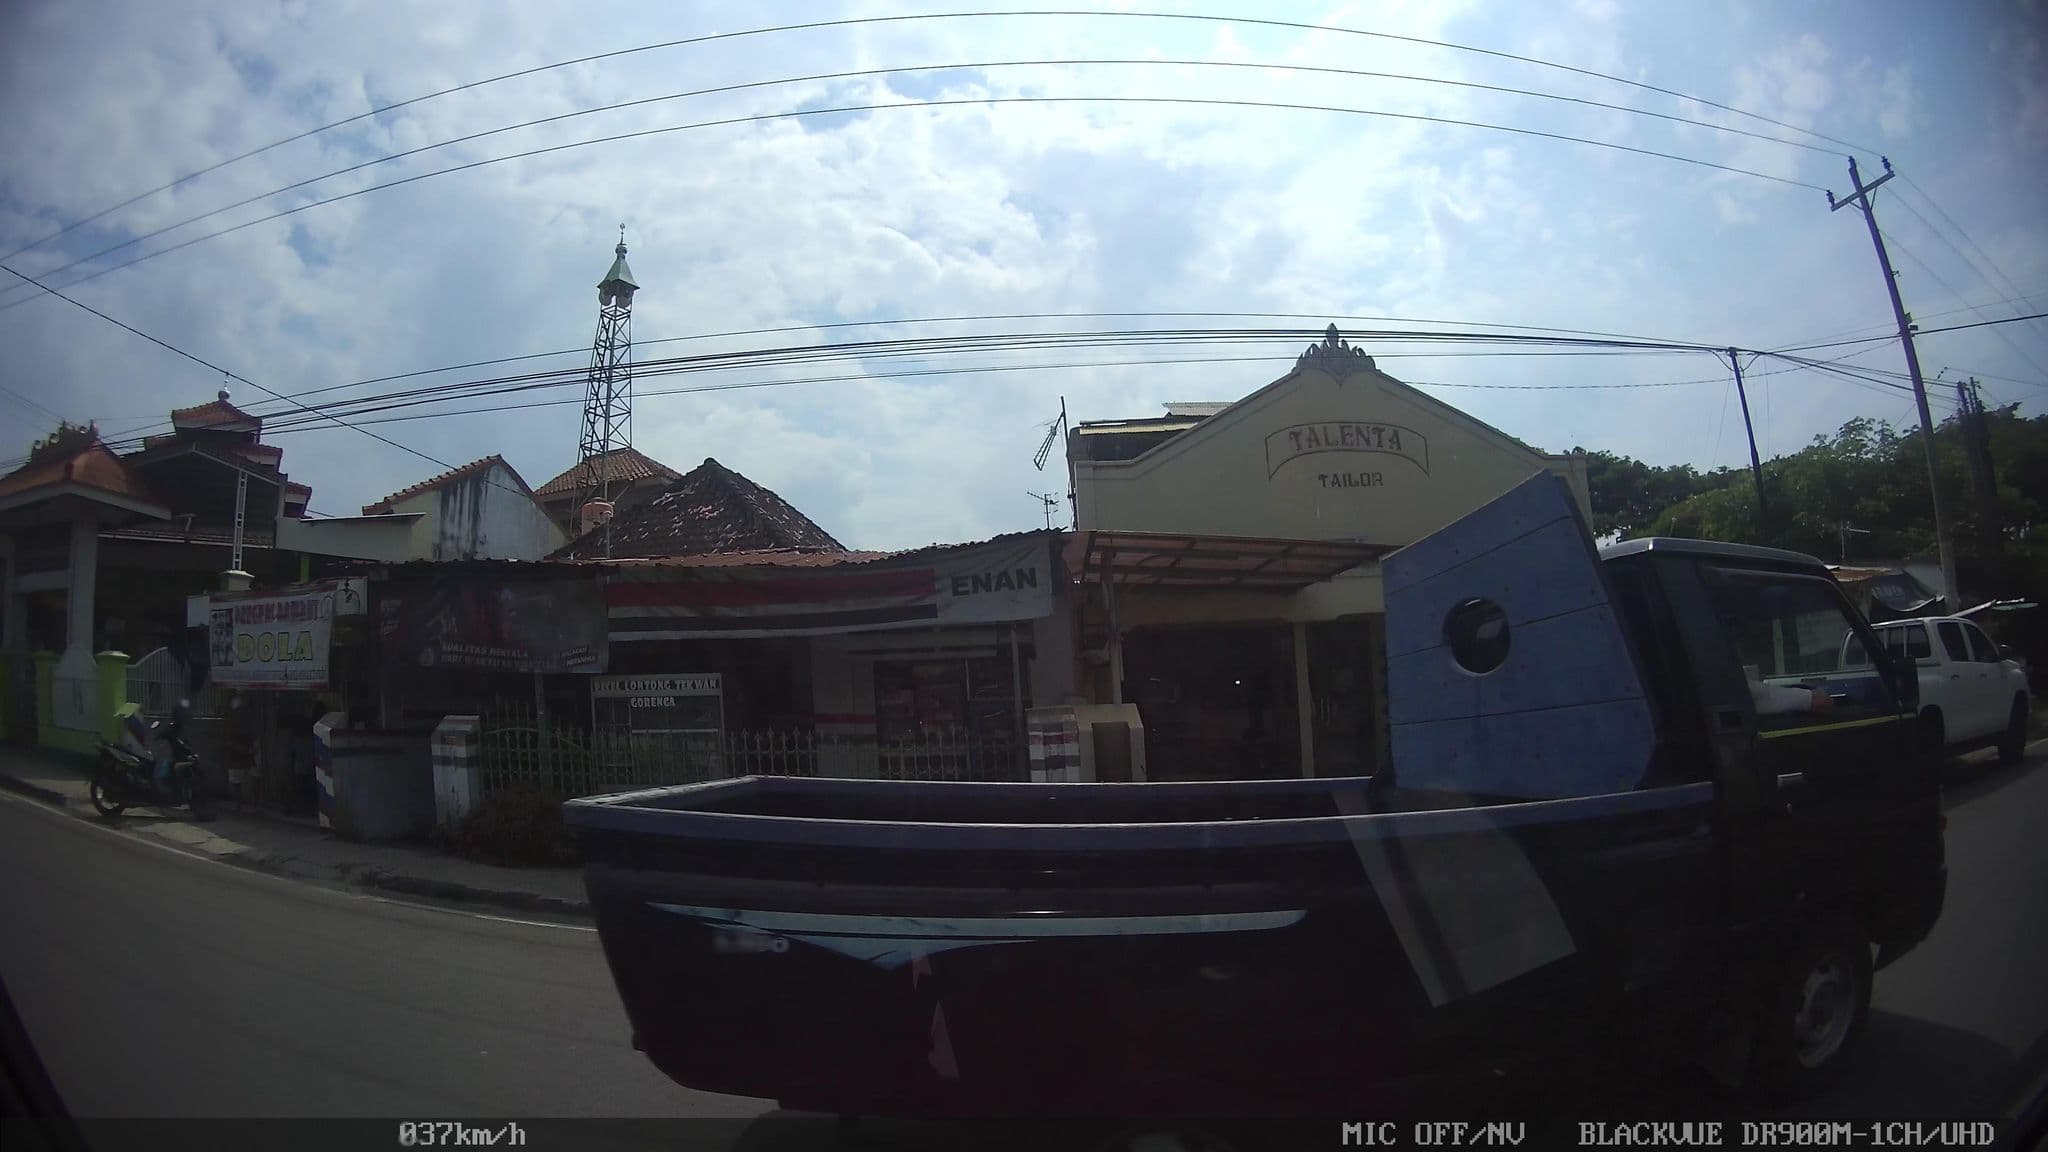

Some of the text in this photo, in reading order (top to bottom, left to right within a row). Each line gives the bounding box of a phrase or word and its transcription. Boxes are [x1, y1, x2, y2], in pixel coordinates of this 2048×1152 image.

[1288, 425, 1402, 451] TALENTA
[1318, 472, 1384, 488] TAILOR
[951, 567, 1037, 597] ENAN
[237, 631, 312, 662] DOLA
[624, 679, 671, 691] LONTONG
